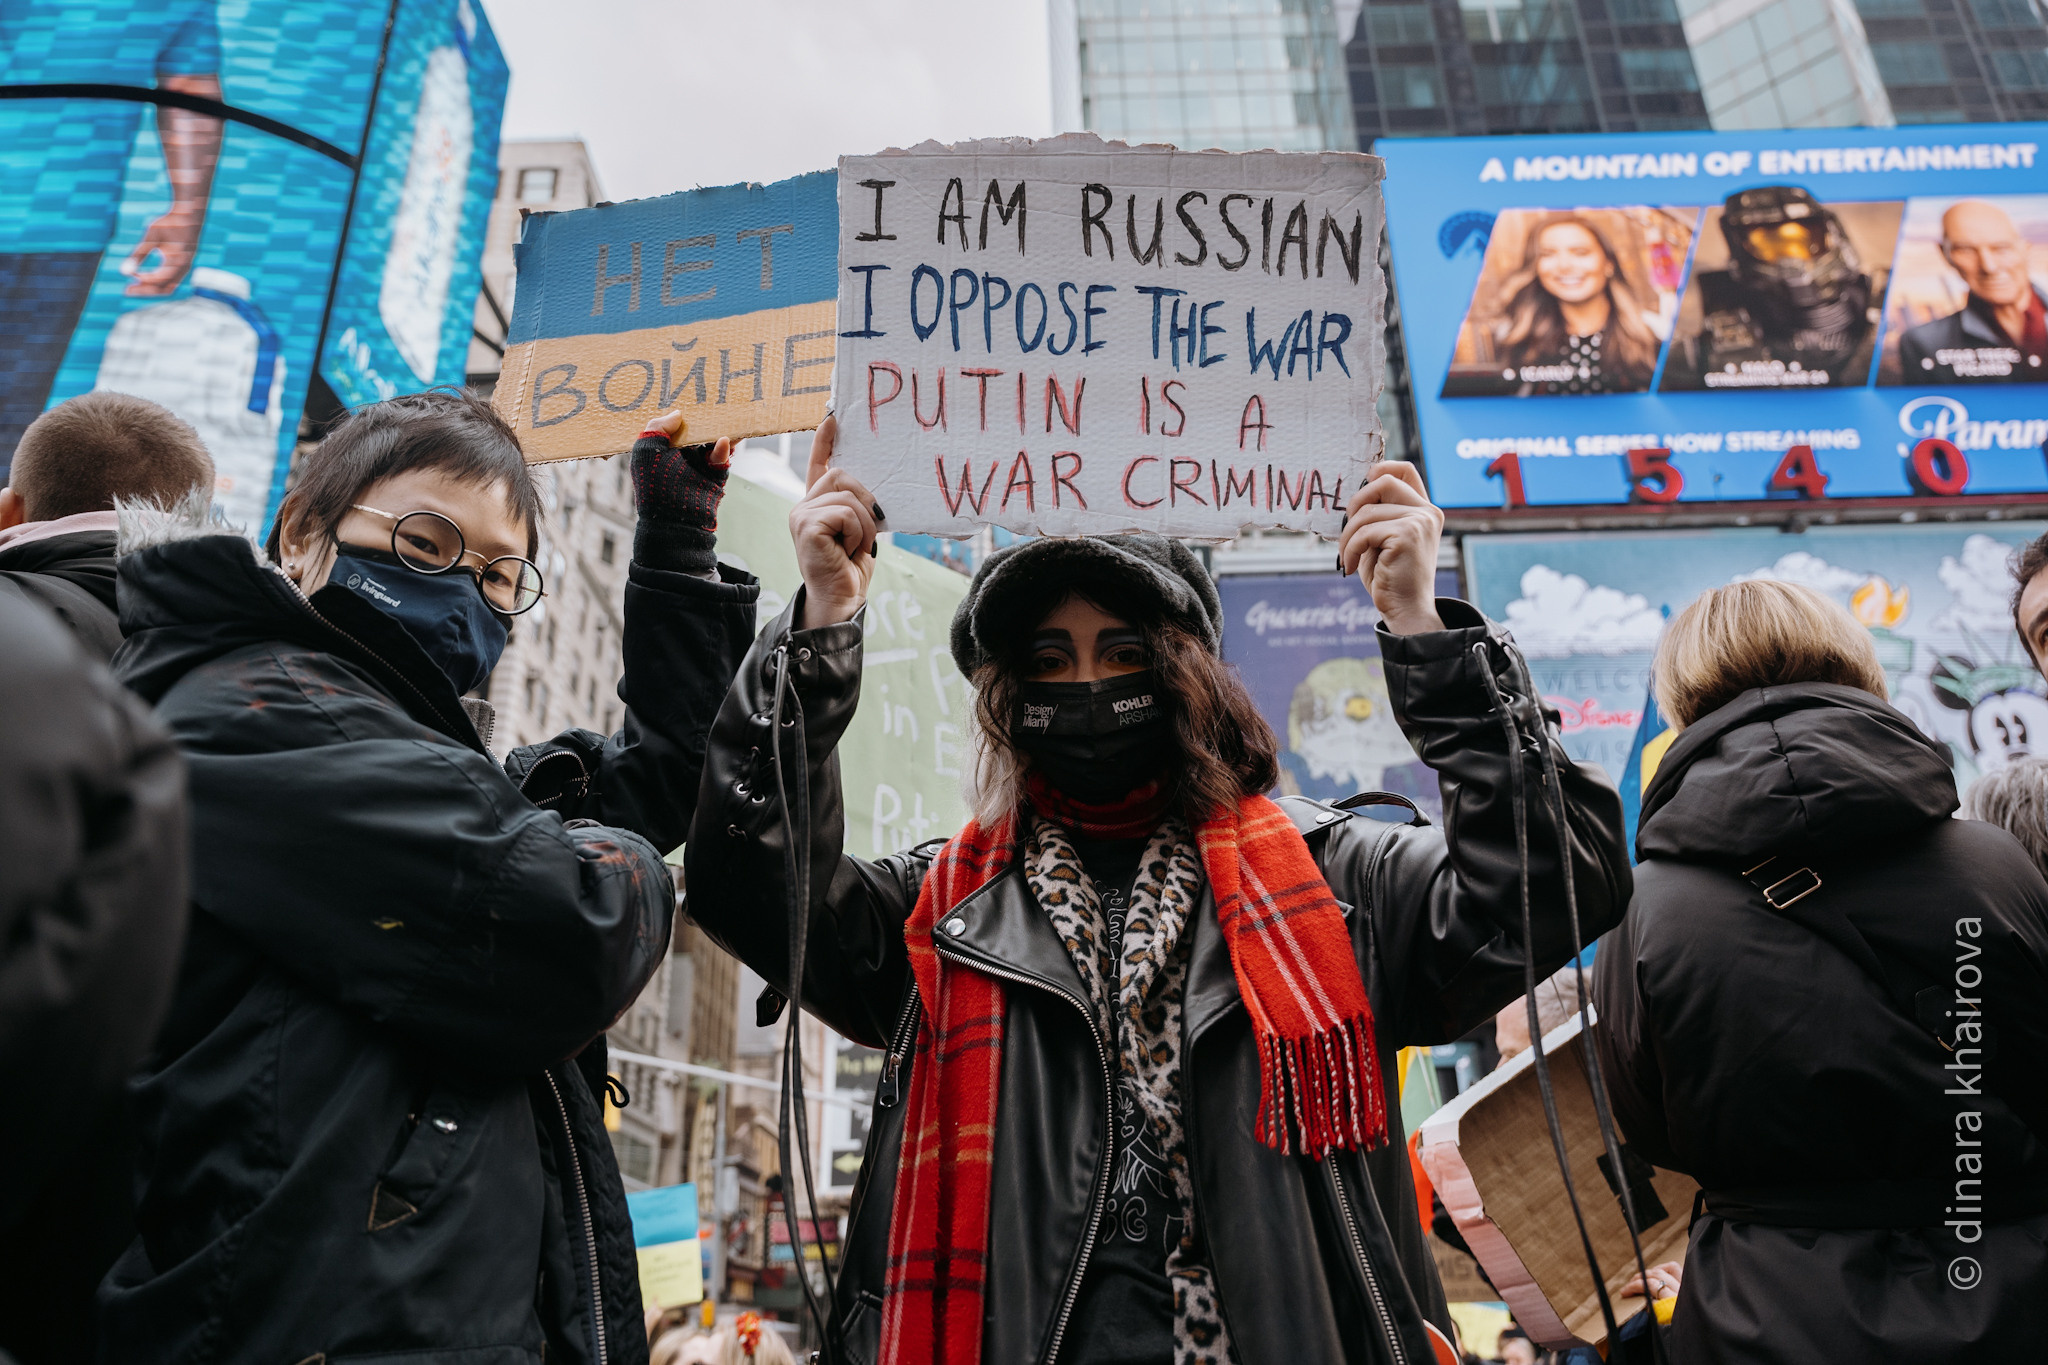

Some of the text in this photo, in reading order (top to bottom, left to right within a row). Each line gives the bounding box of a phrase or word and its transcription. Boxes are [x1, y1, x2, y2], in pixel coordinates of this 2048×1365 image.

[1479, 143, 2038, 182] A MOUNTAIN OF ENTERTAINMENT
[590, 224, 794, 317] НЕТ
[855, 177, 1363, 285] I AM RUSSIAN
[838, 262, 1352, 381] I OPPOSE THE WAR
[531, 328, 836, 429] ВОЙНЕ
[866, 361, 1275, 452] PUTIN IS A
[1456, 428, 1860, 459] ORIGINAL SERIES NOW STREAMING
[934, 450, 1348, 517] WAR CRIMINAL
[881, 684, 920, 743] in
[1112, 694, 1155, 714] KOHLER
